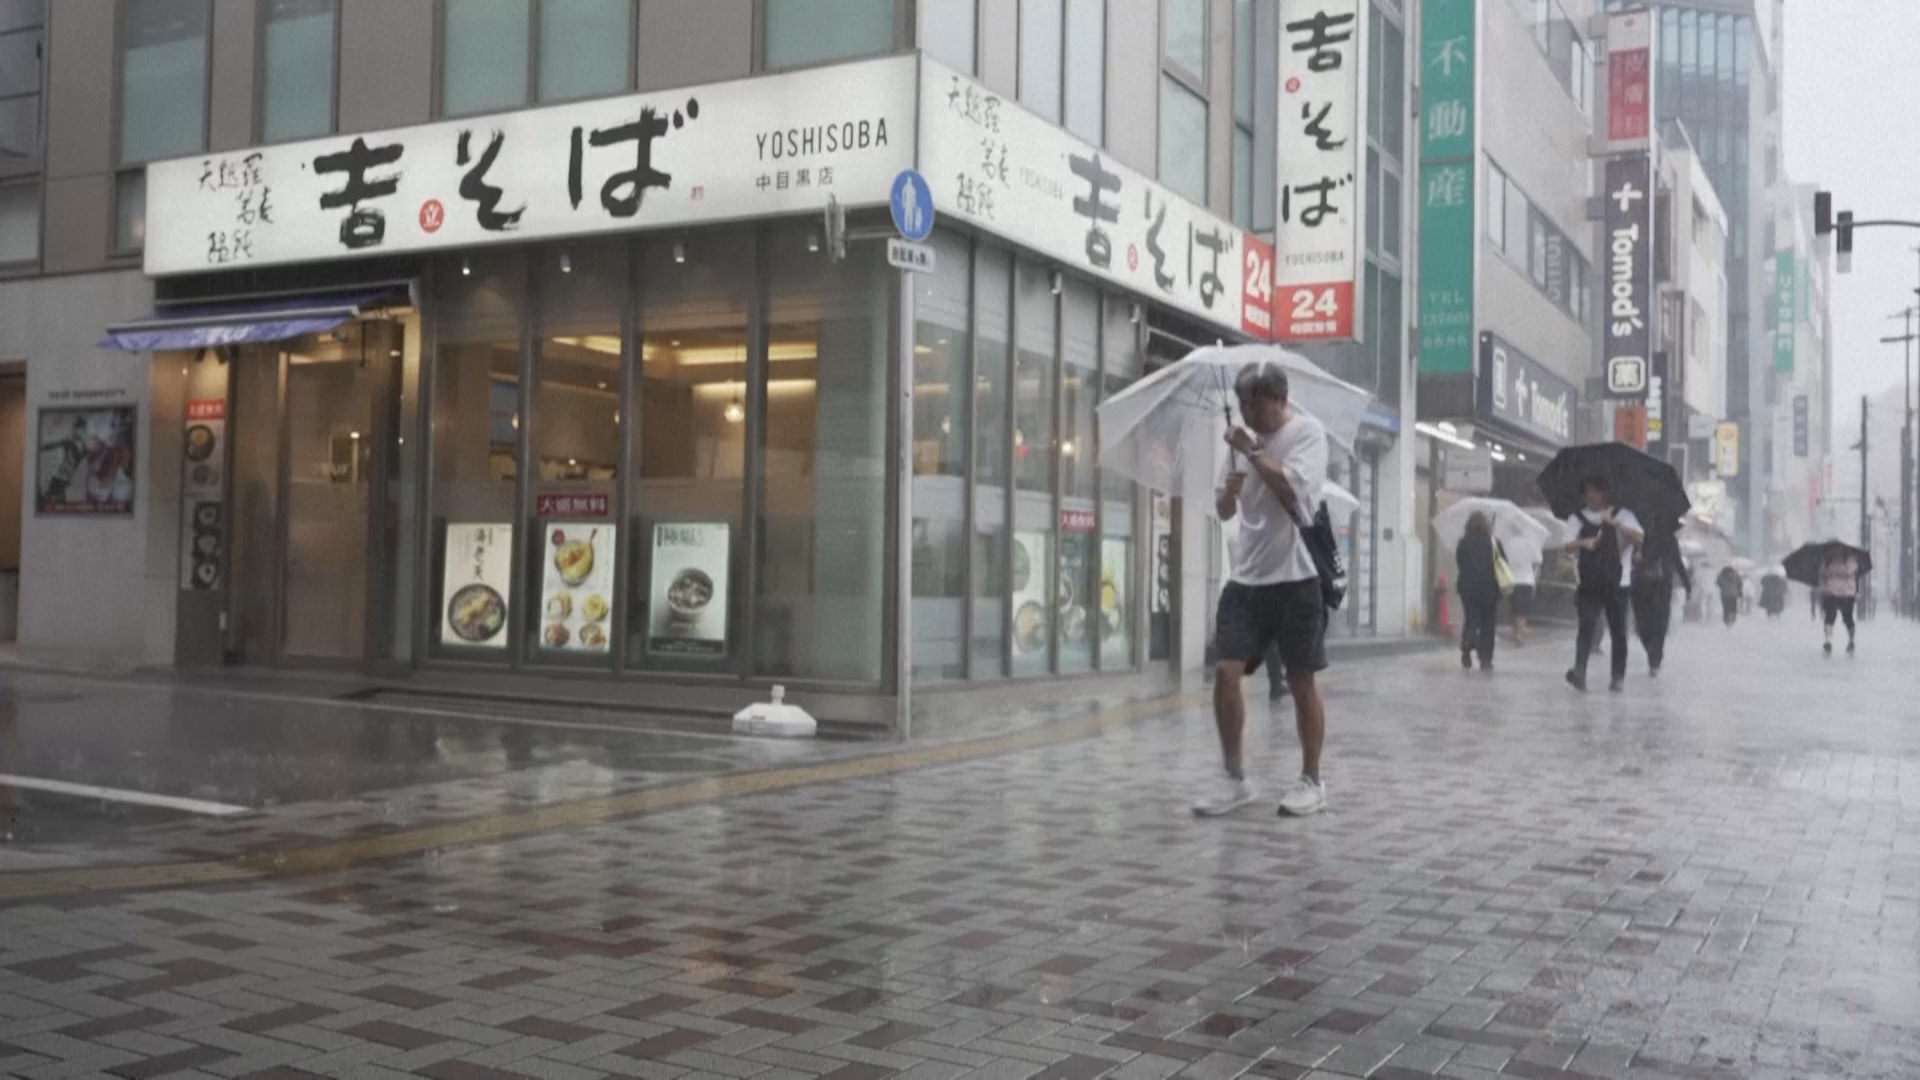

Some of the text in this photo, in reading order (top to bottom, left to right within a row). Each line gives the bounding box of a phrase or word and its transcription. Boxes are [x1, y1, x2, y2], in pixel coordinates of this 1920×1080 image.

[314, 97, 699, 248] 吉そば
[756, 117, 888, 161] YOSHISOBA
[1282, 10, 1354, 228] 吉そば
[1427, 34, 1468, 207] 不動産
[755, 166, 833, 192] 中目黒店
[1069, 152, 1234, 309] 吉そば
[1245, 248, 1272, 304] 24
[1290, 287, 1338, 319] 24
[1611, 223, 1644, 337] Tomod's
